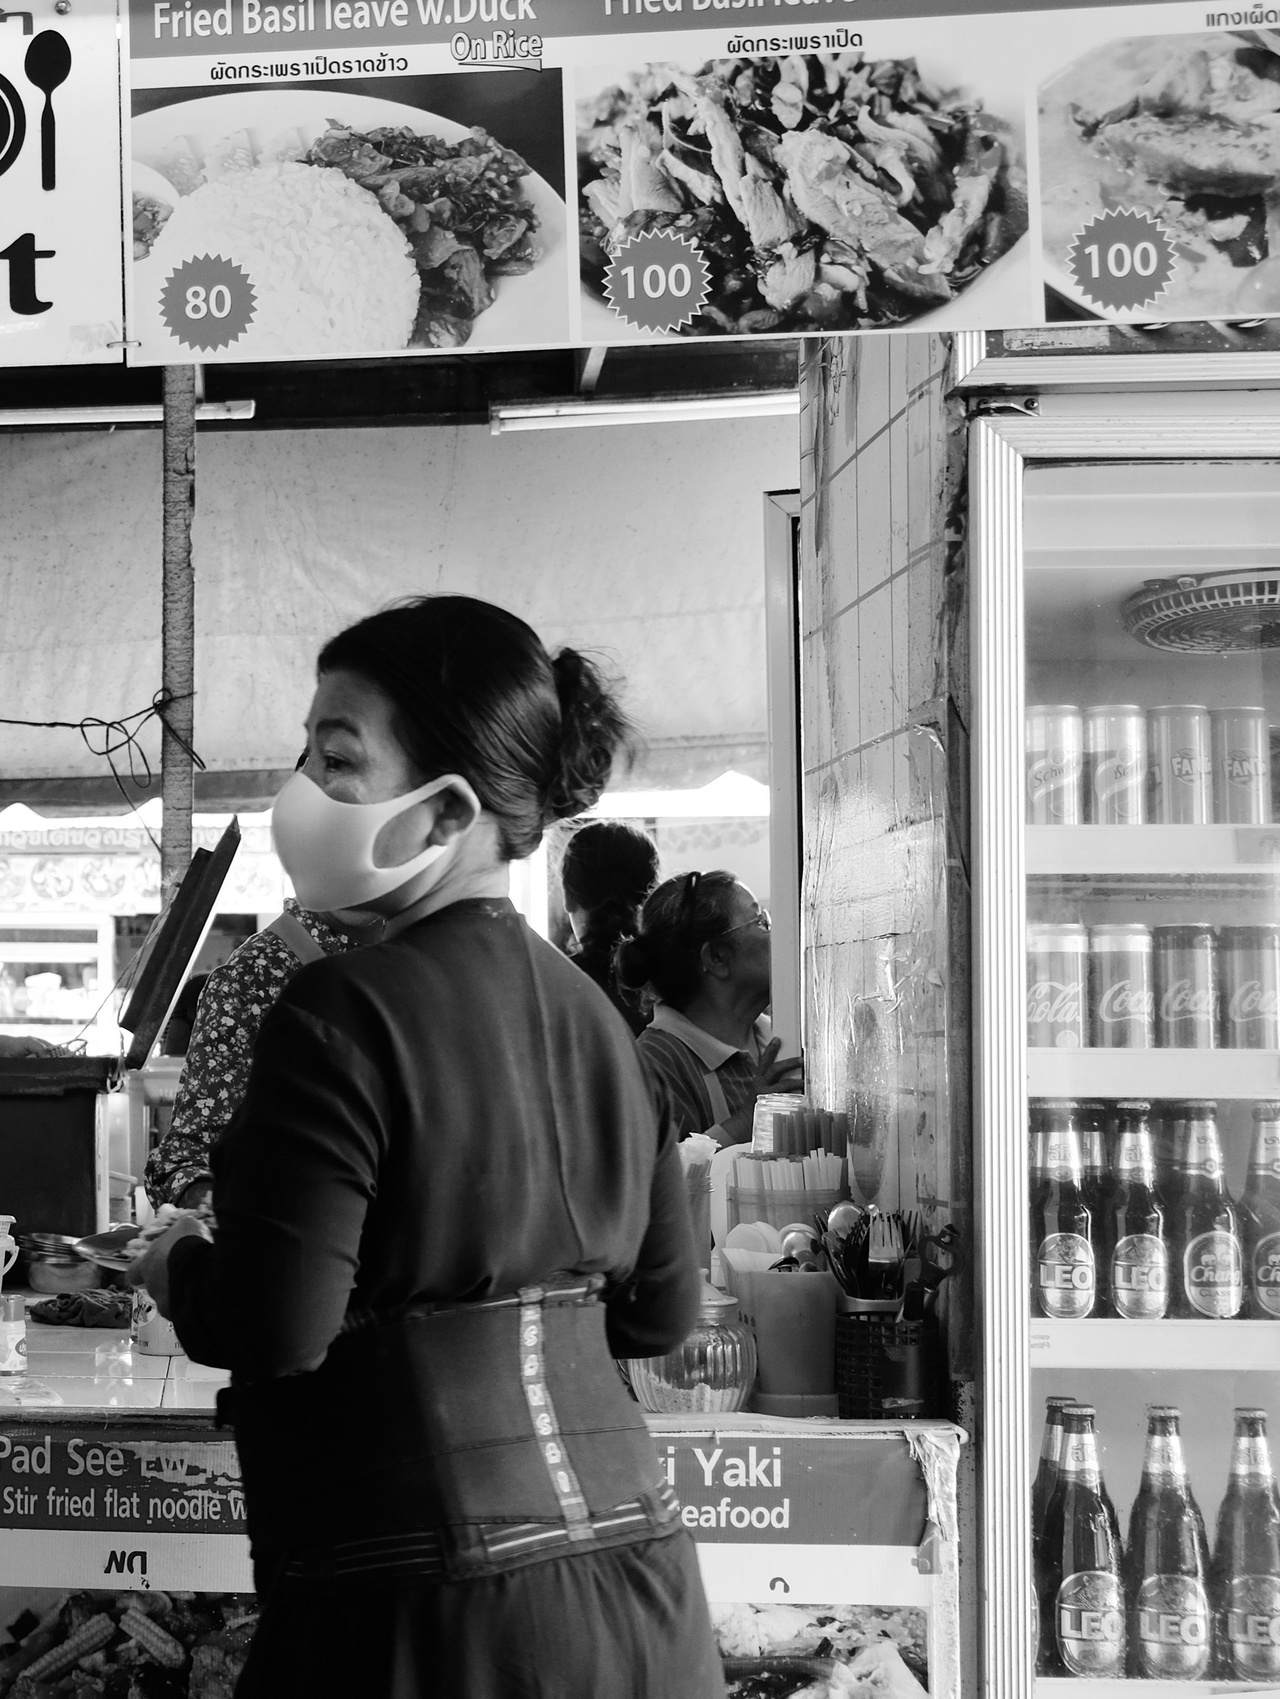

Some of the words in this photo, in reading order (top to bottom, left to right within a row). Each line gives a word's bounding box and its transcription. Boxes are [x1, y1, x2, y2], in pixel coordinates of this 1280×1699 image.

[154, 1, 233, 39] Fried
[242, 0, 315, 35] Basil
[325, 0, 409, 31] leave
[450, 31, 485, 61] On
[491, 29, 543, 59] Rice
[727, 28, 863, 54] ผัดกระเพราเป็ด
[1084, 241, 1158, 279] 100
[620, 263, 692, 300] 100
[184, 285, 232, 320] 80
[1039, 1264, 1094, 1289] LEO
[1115, 1265, 1166, 1290] LEO
[67, 1438, 125, 1477] See
[691, 1446, 782, 1488] Yaki
[3, 1486, 38, 1515] Stir
[46, 1486, 95, 1517] fried
[104, 1488, 140, 1519] flat
[148, 1493, 221, 1520] noodle
[677, 1497, 790, 1529] eafood
[1060, 1609, 1122, 1639] LEO
[1140, 1610, 1206, 1643] LEO
